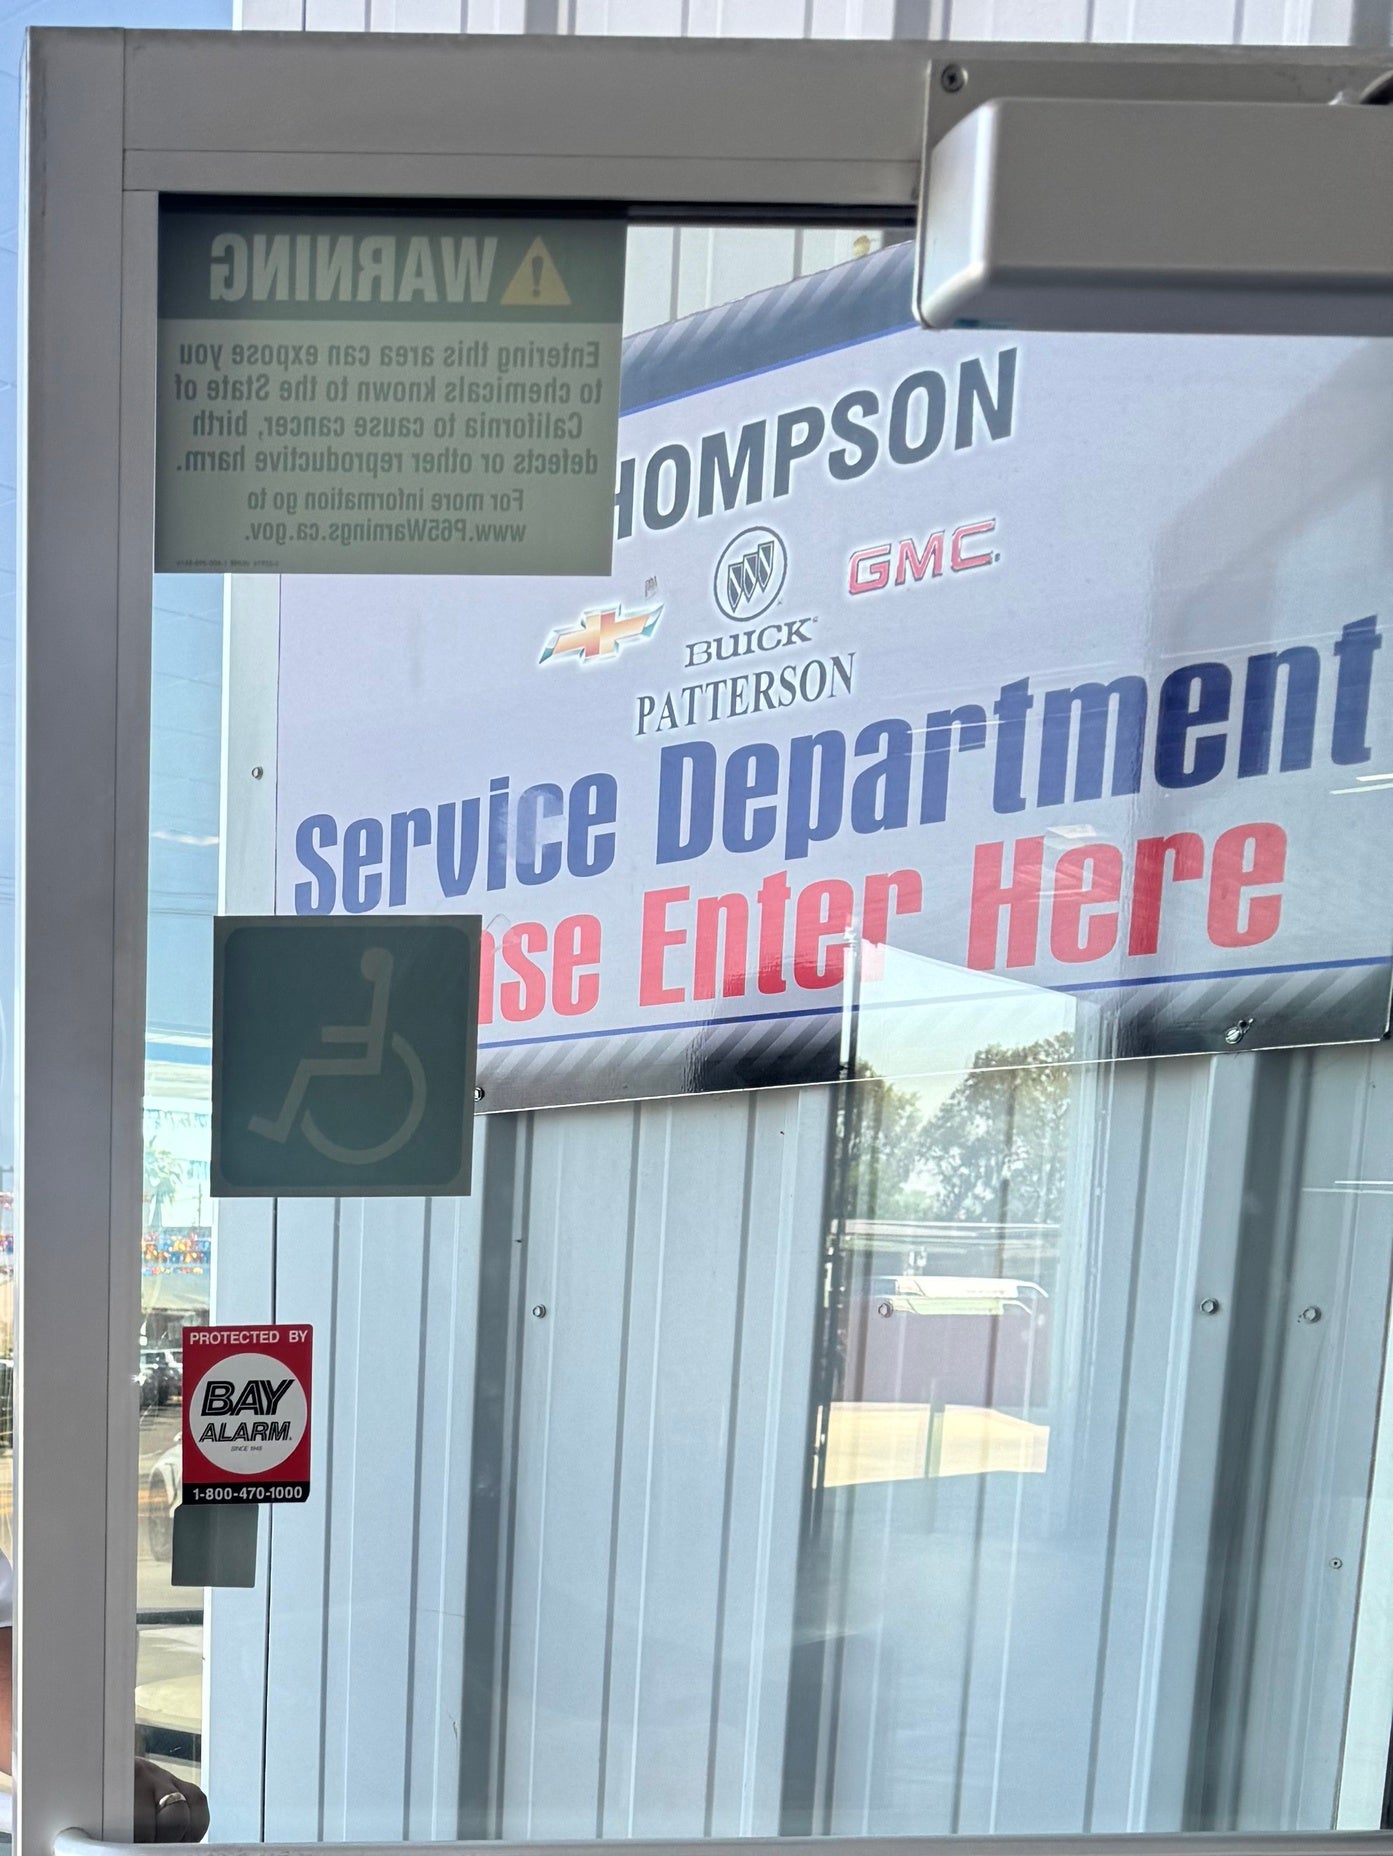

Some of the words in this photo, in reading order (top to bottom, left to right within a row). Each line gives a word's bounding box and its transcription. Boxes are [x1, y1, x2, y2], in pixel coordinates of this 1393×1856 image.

[848, 518, 996, 595] GMC
[684, 617, 813, 668] BUICK
[636, 652, 856, 736] PATTERSON
[294, 772, 617, 916] Service
[655, 614, 1382, 864] Department
[638, 866, 922, 1005] Enter
[967, 822, 1287, 972] Here
[189, 1330, 280, 1345] PROTECTED
[288, 1329, 309, 1343] BY
[200, 1379, 296, 1416] BAY
[198, 1421, 291, 1443] ALARM
[192, 1486, 303, 1500] 1-800-470-1000
